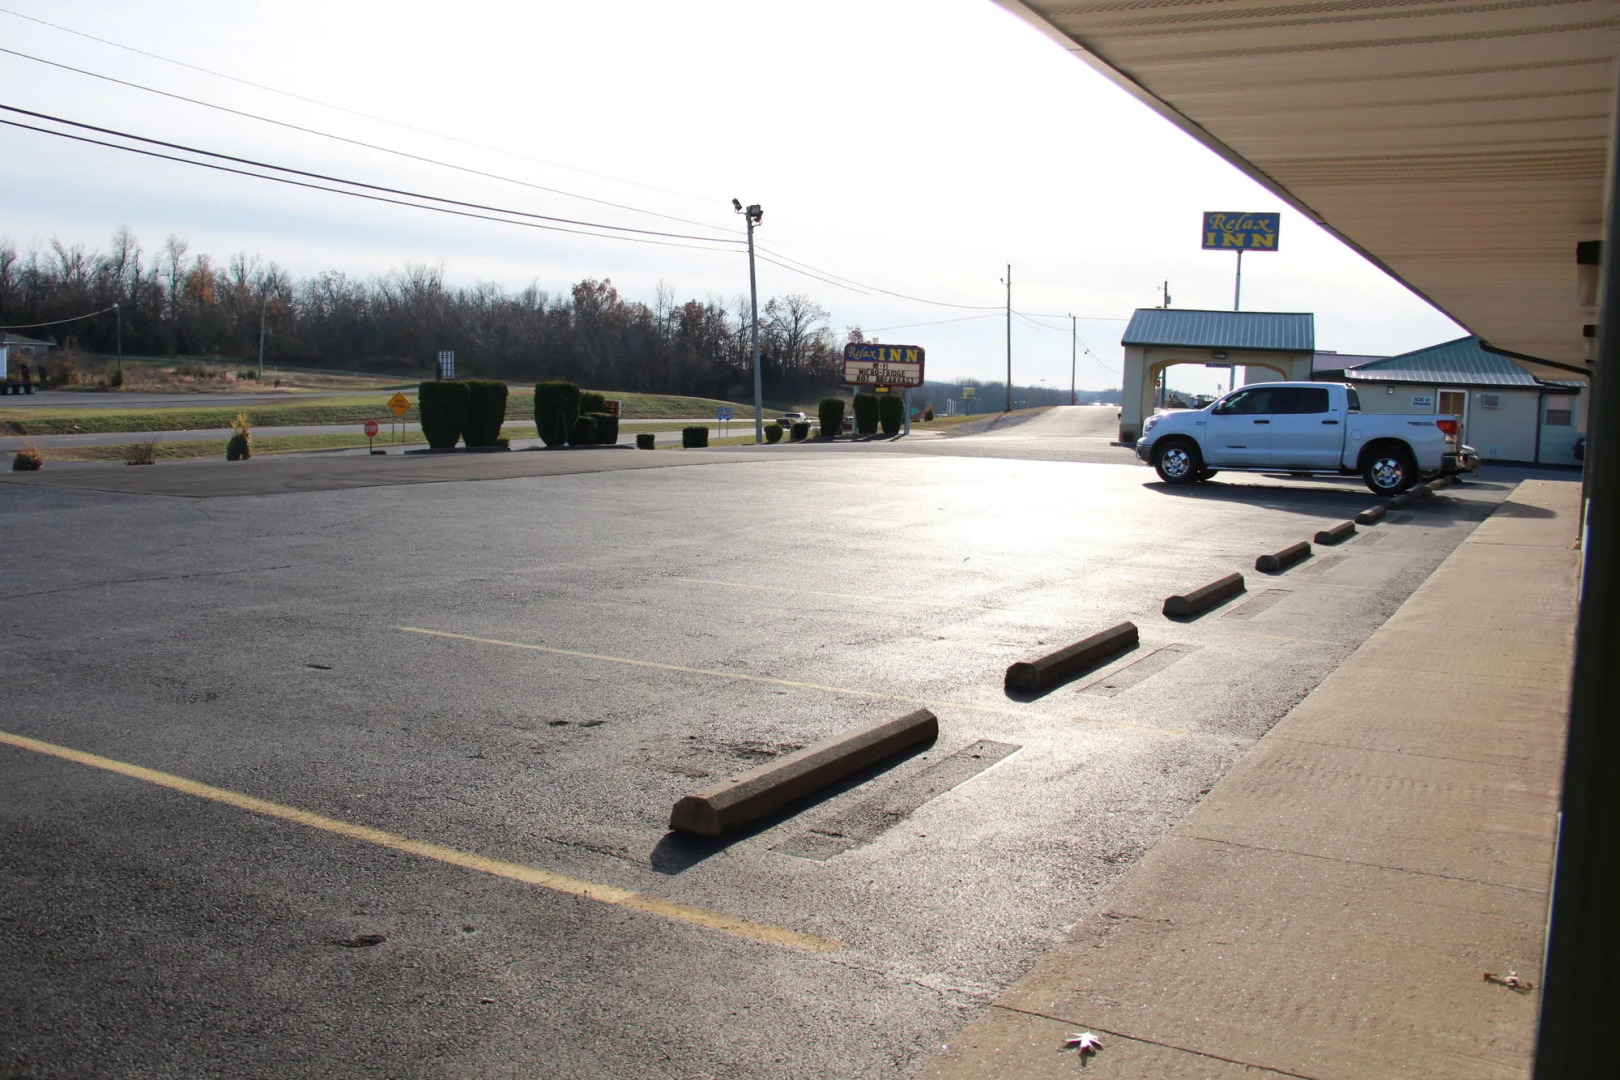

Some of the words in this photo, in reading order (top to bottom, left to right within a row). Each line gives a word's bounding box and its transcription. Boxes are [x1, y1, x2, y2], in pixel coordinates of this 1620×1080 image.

[1208, 213, 1273, 233] Relax
[1206, 232, 1275, 247] INN
[847, 346, 878, 360] Relax
[878, 348, 919, 362] INN
[876, 376, 914, 384] BREAKFAST
